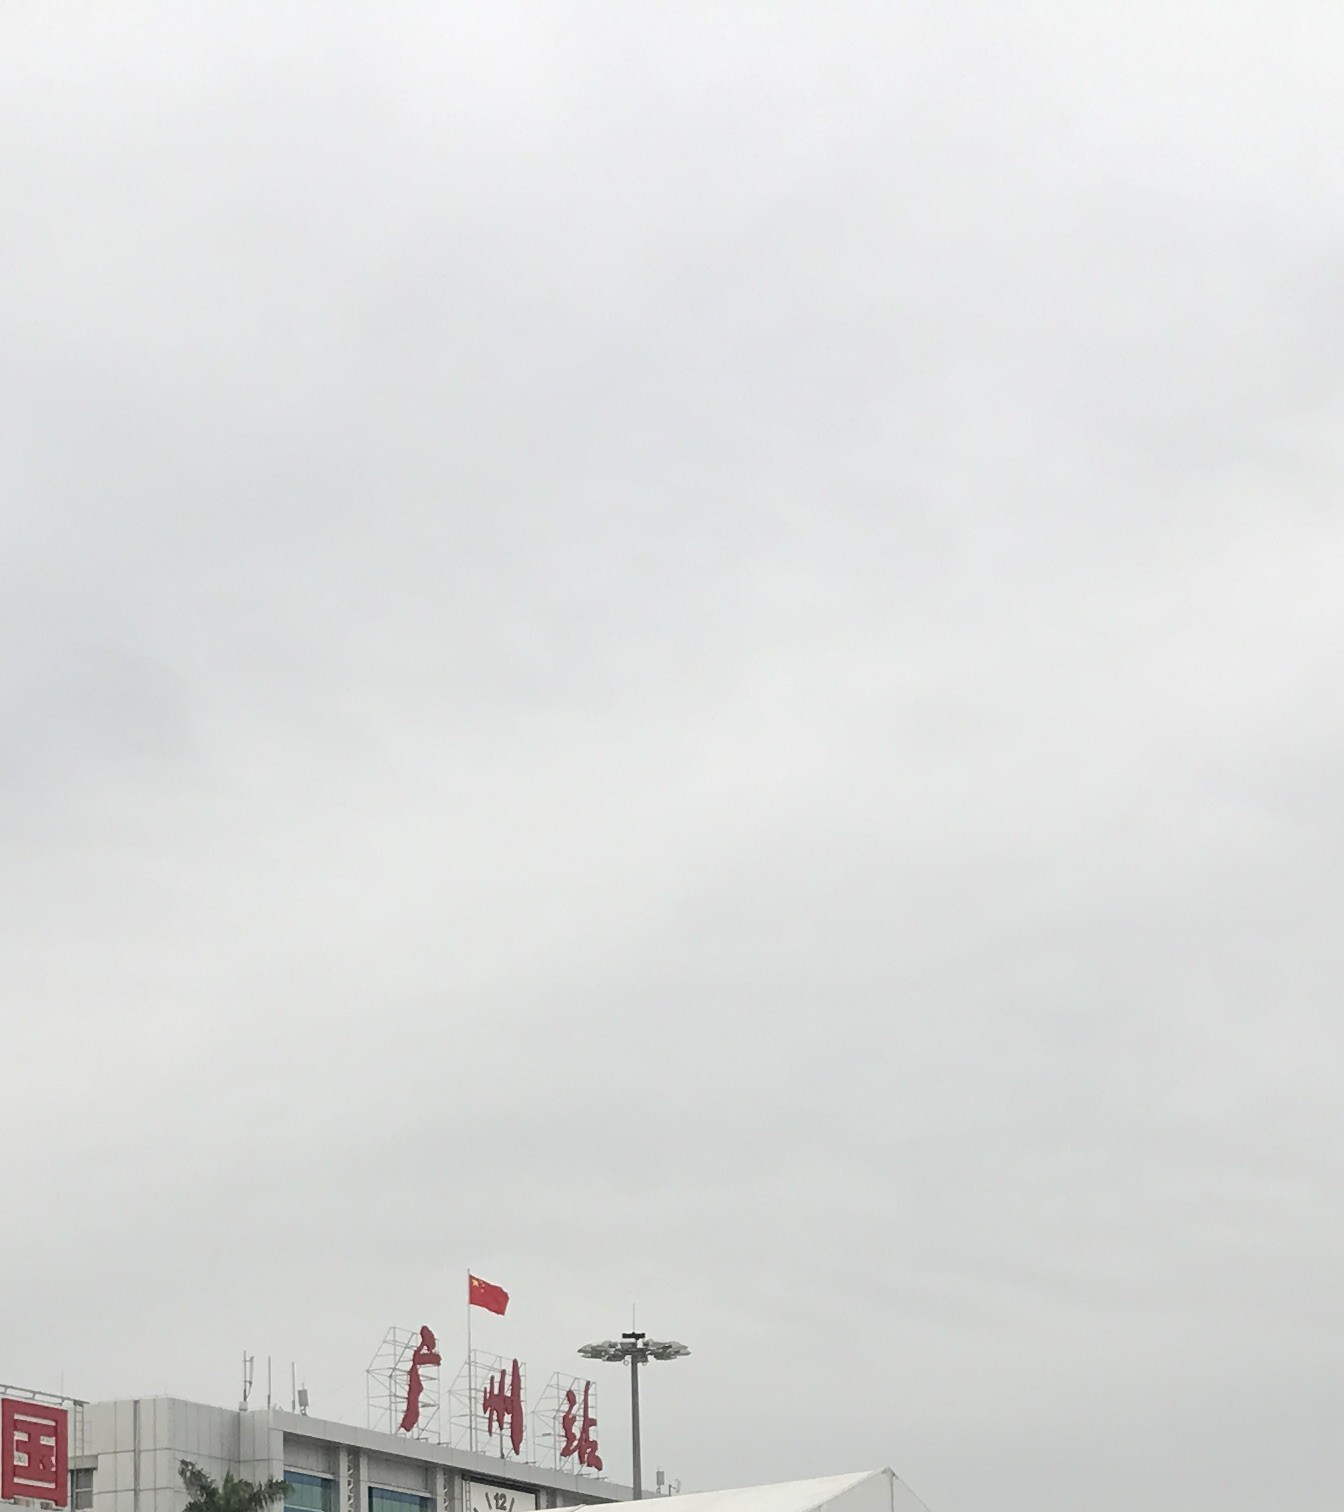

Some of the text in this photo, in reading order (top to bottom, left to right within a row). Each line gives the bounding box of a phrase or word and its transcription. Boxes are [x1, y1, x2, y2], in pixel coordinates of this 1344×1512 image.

[400, 1325, 603, 1472] 广州站
[493, 1493, 508, 1512] 12
